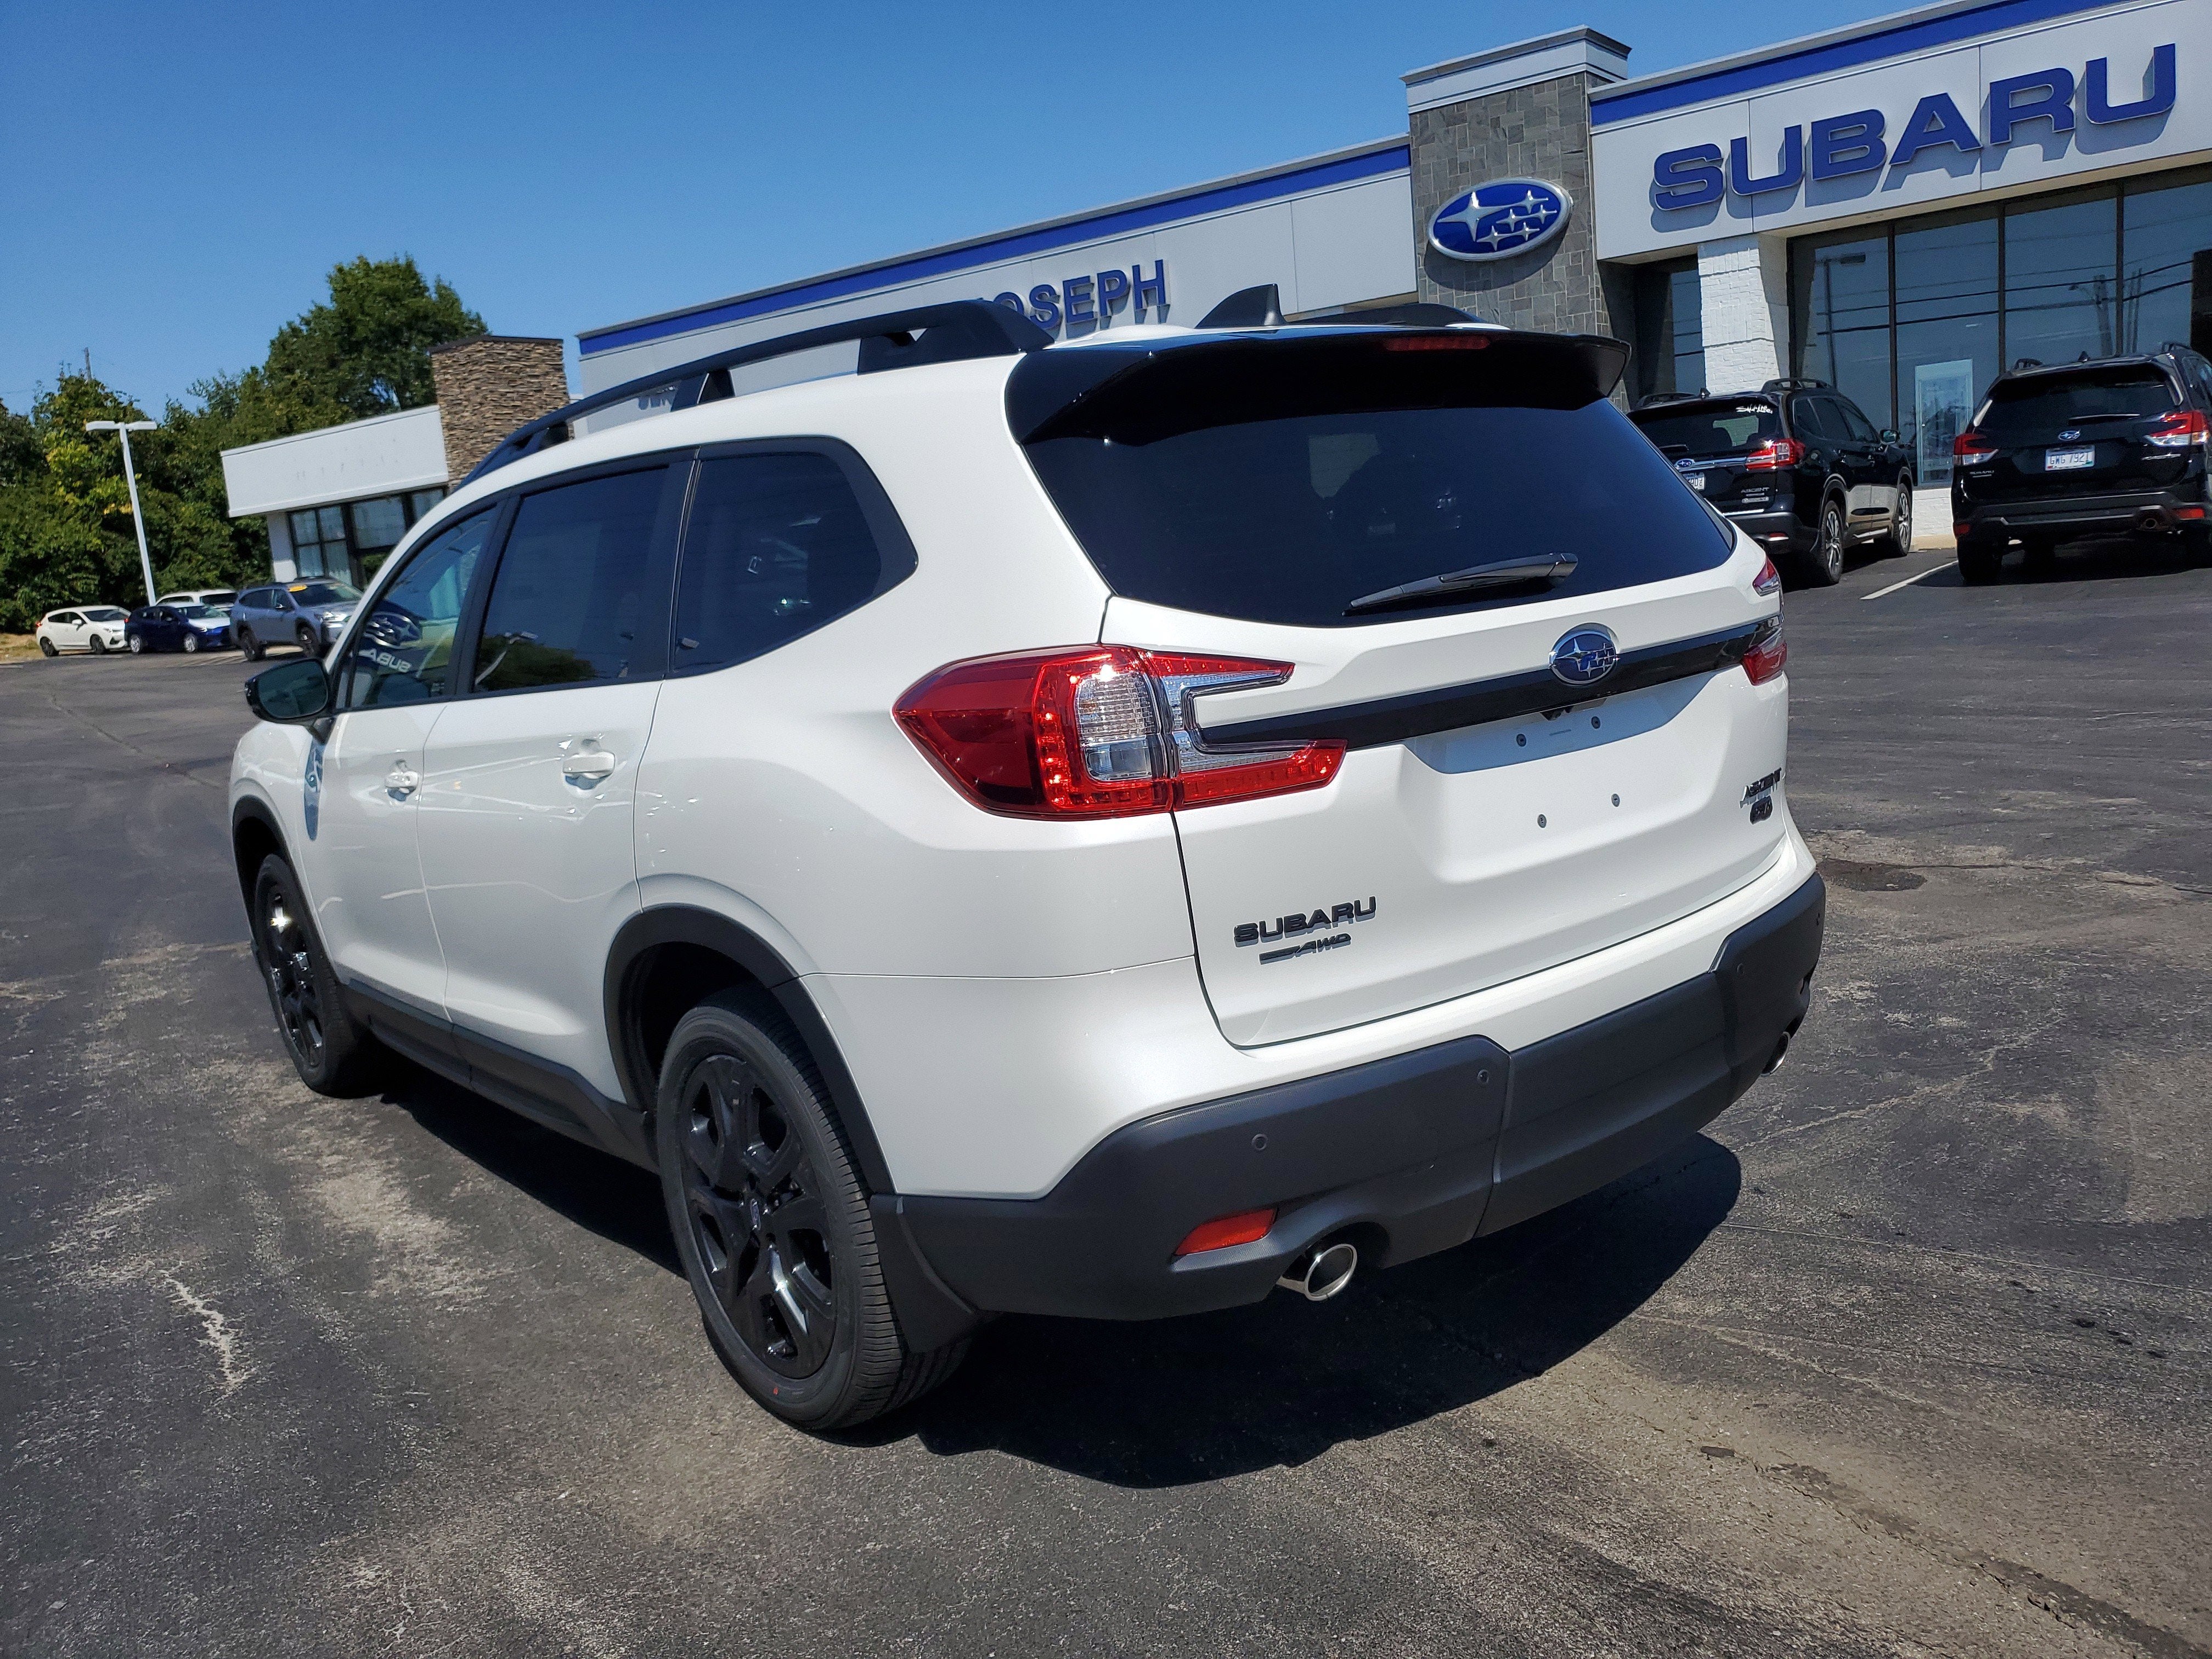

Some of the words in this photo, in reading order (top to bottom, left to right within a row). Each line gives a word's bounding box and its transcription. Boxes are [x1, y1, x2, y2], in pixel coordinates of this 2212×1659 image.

[1654, 43, 2176, 211] SUBARU
[979, 259, 1166, 330] SEPH
[1233, 896, 1376, 942] SUBARU
[1295, 933, 1352, 953] AWD
